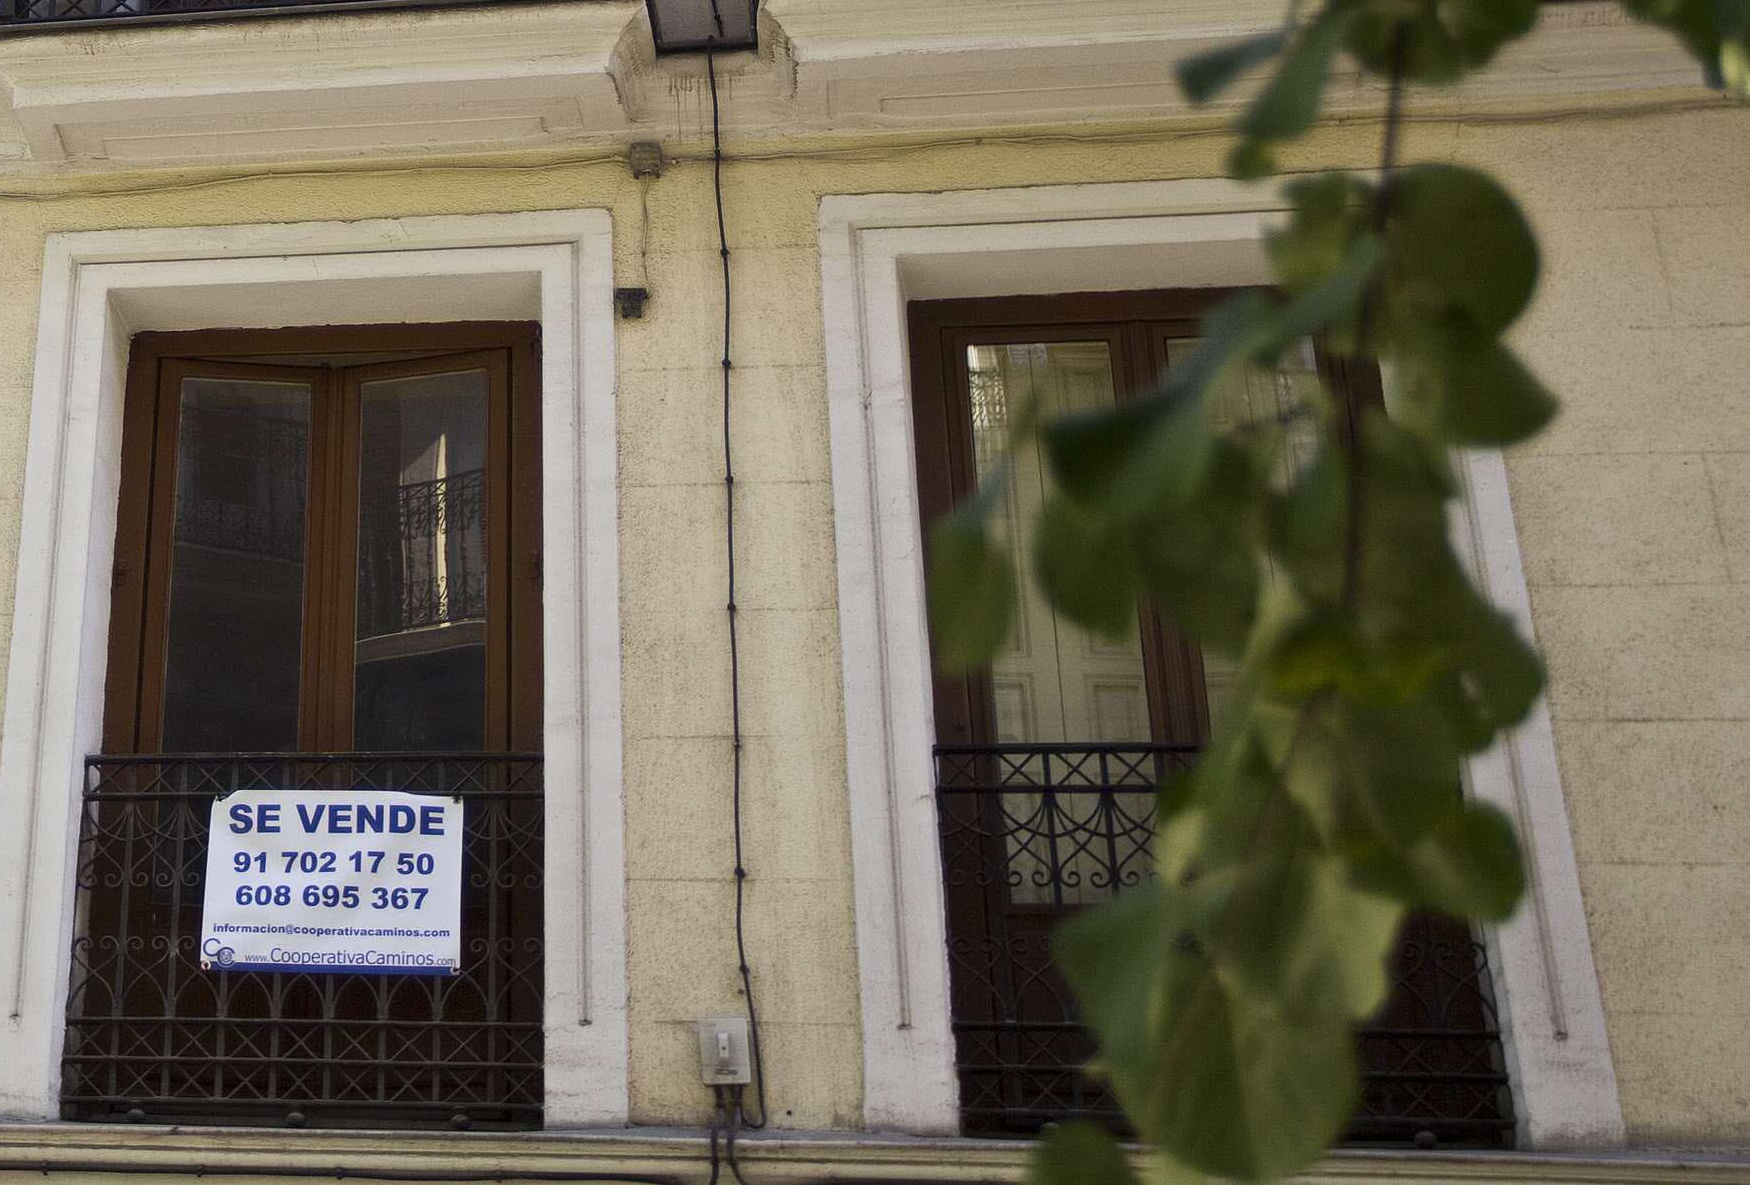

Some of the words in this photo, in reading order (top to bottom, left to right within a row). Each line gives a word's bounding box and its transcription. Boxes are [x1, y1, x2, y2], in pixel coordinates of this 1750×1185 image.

[229, 803, 282, 834] SE
[296, 804, 445, 836] VENDE
[233, 851, 267, 873] 91
[281, 851, 336, 873] 702
[349, 851, 385, 873] 17
[397, 853, 435, 875] 50
[235, 885, 291, 906] 608
[302, 885, 359, 909] 695
[371, 887, 429, 910] 367
[213, 923, 450, 938] informacion@cooperativacaminos.com
[244, 948, 456, 966] www.CooperativaCaminos.com
